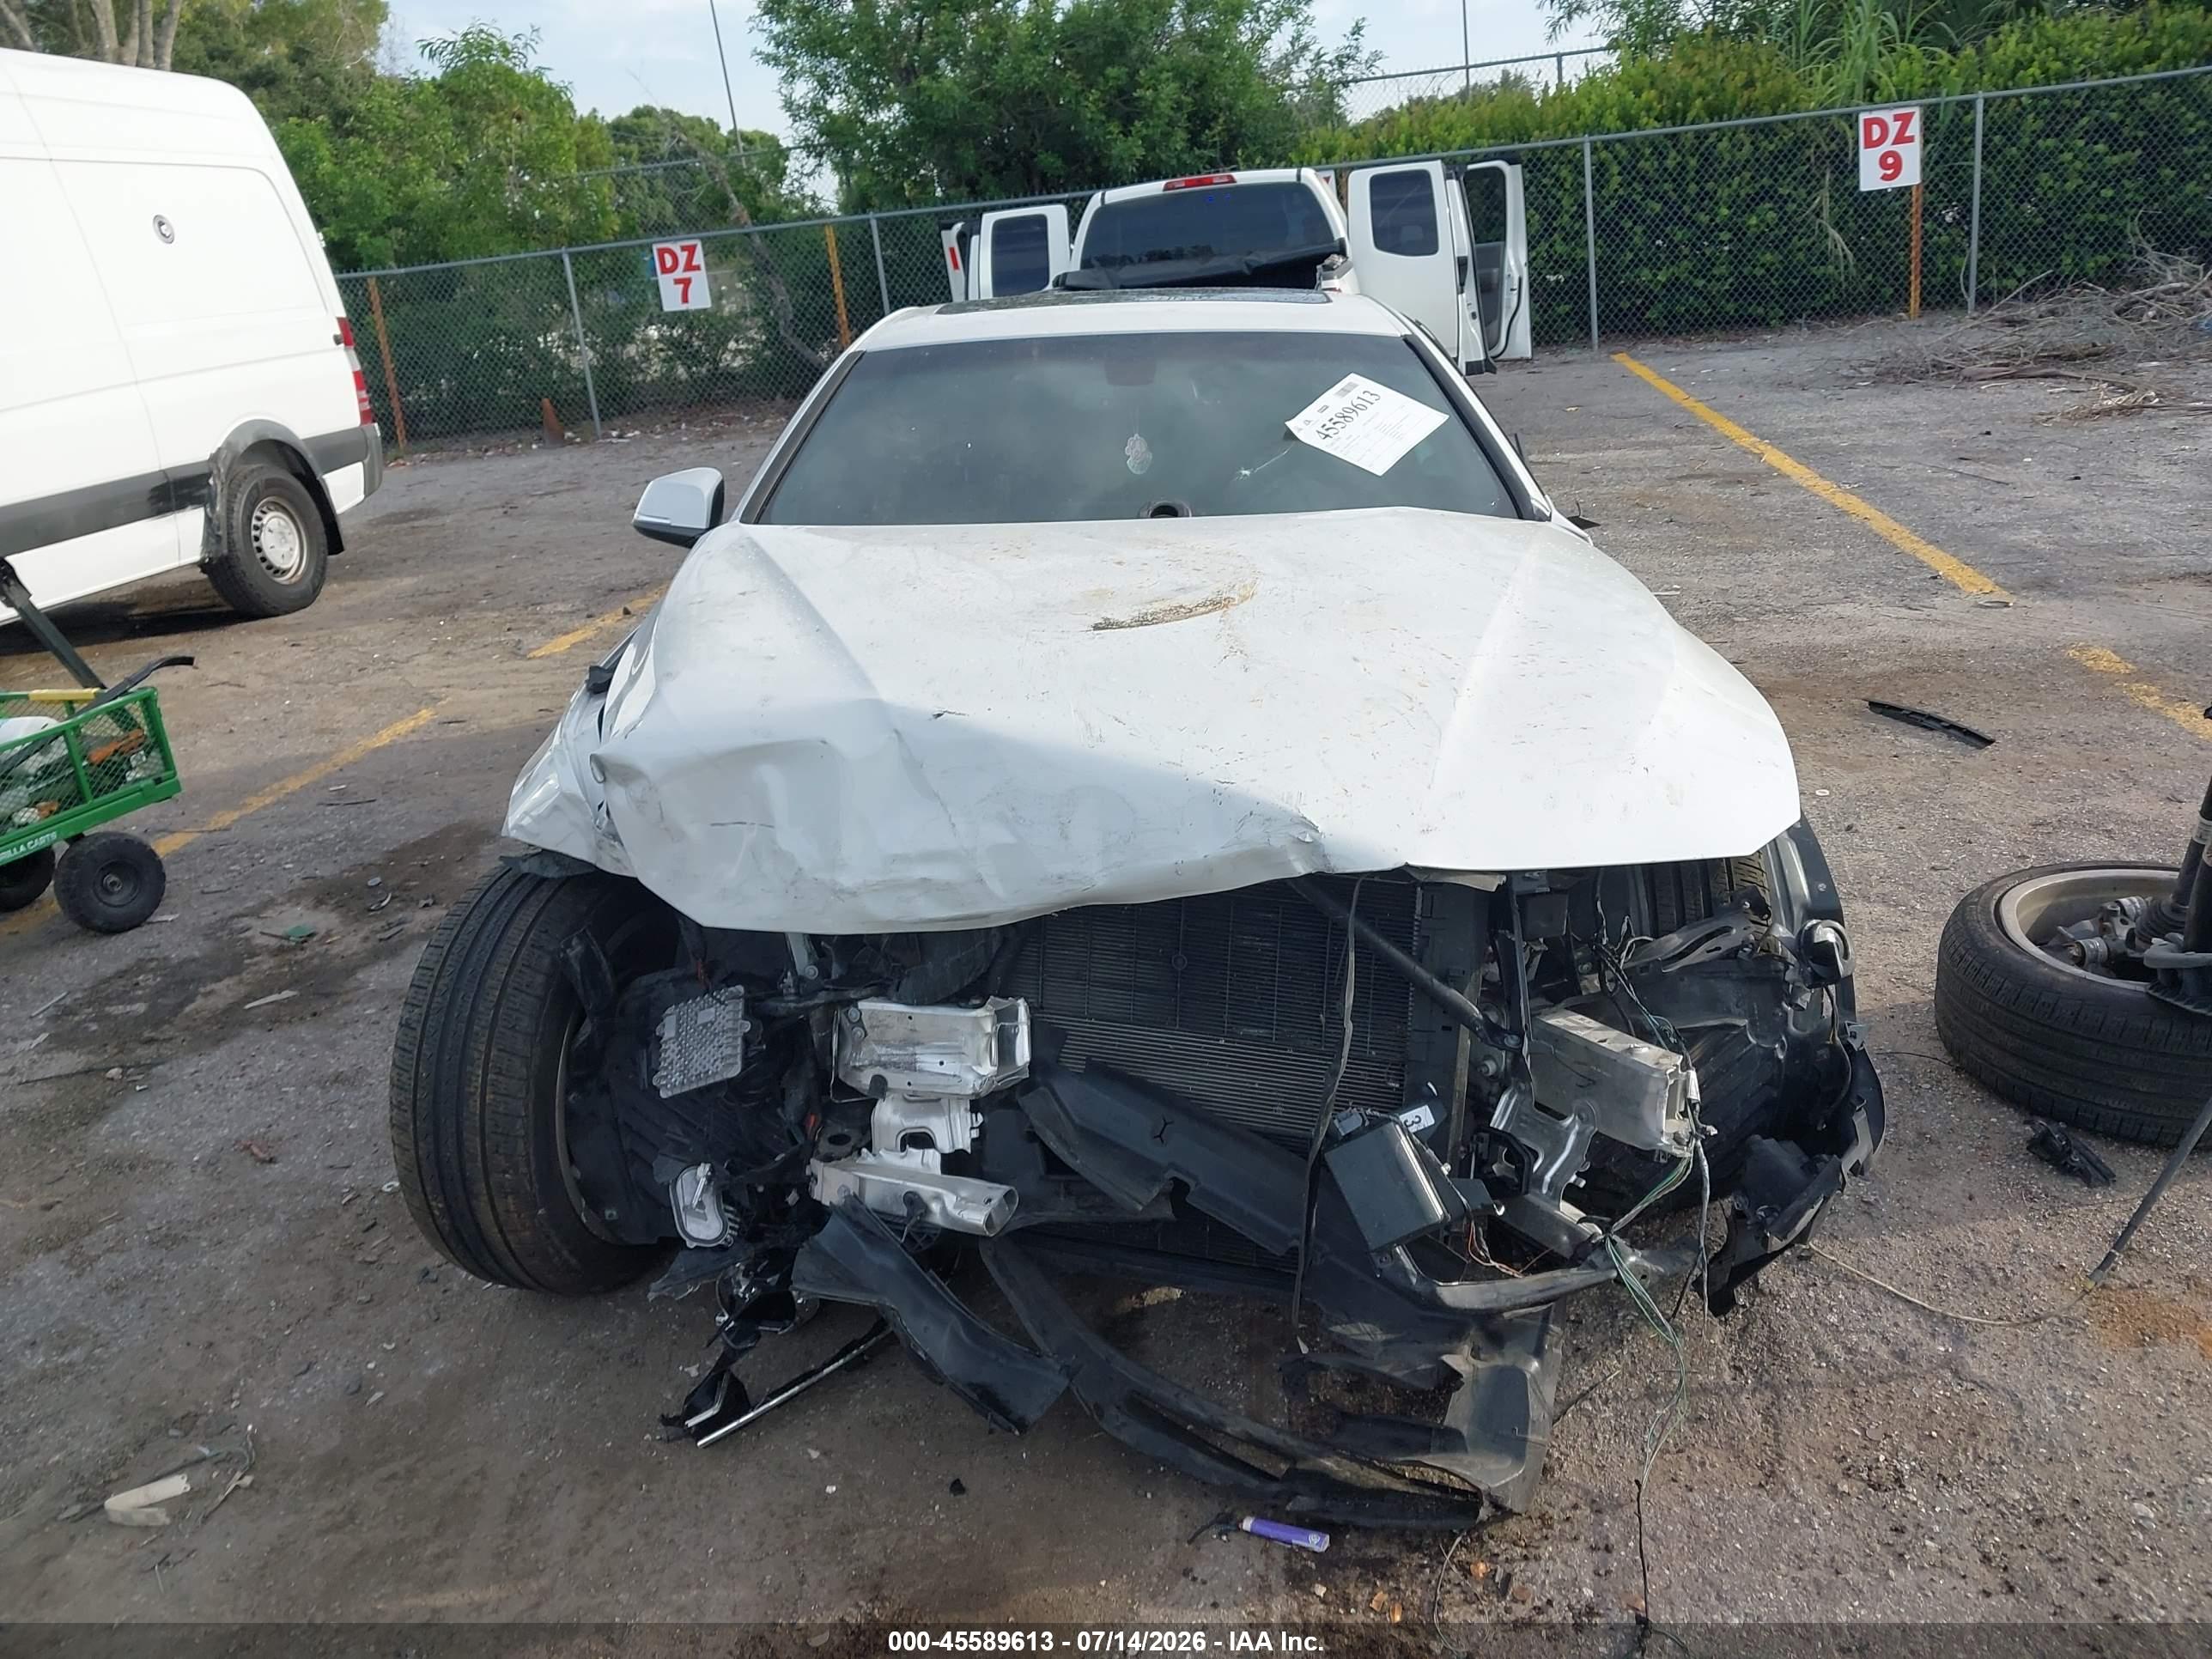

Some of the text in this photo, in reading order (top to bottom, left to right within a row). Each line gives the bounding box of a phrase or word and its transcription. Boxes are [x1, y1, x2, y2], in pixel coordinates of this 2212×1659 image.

[1863, 111, 1916, 149] DZ
[1879, 150, 1903, 181] 9
[656, 243, 702, 275] DZ
[673, 276, 692, 304] 7
[1316, 390, 1381, 441] 45589613
